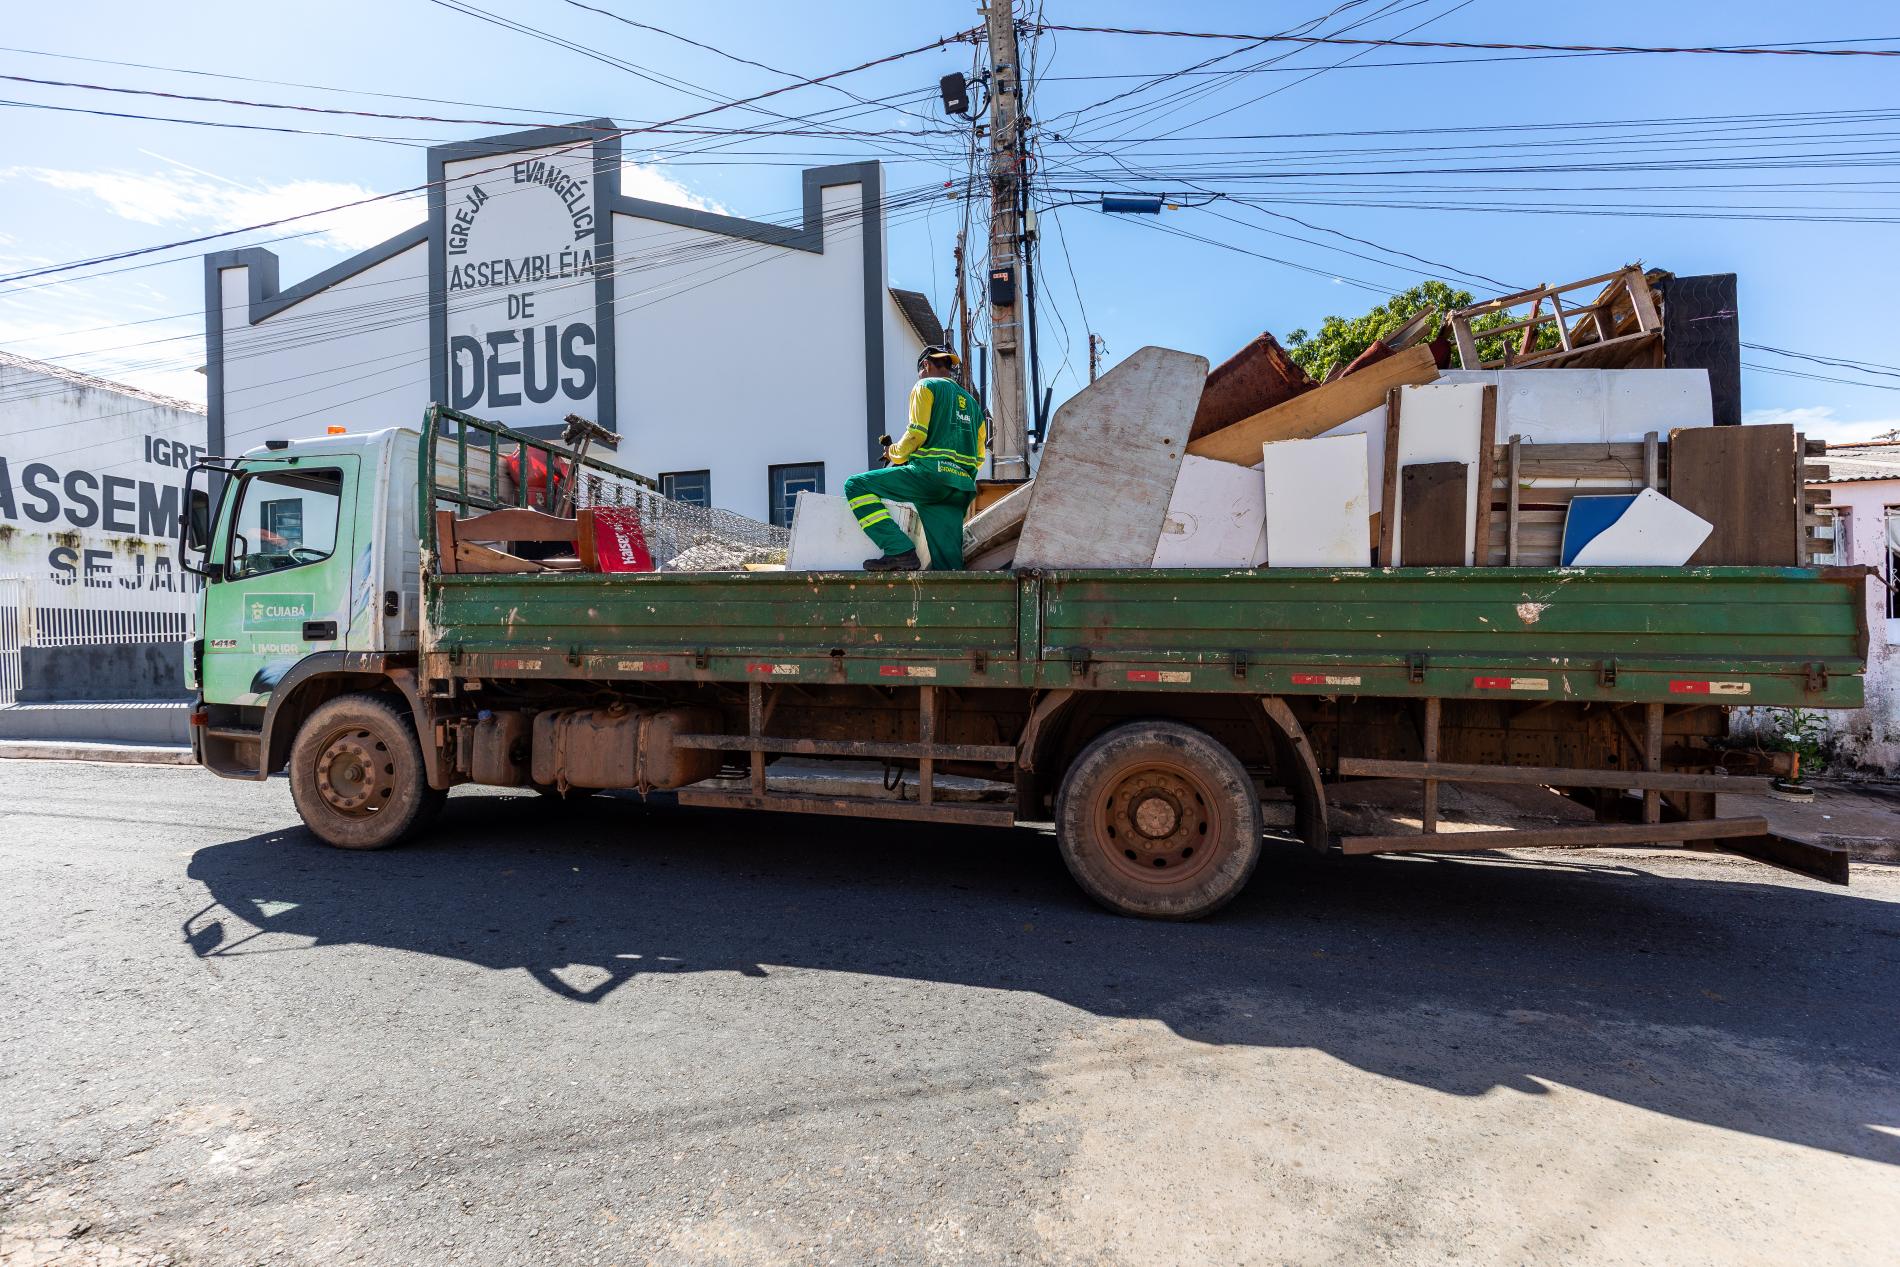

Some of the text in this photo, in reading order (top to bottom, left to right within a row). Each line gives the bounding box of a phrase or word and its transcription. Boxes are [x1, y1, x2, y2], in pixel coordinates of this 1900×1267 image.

[449, 160, 595, 255] IGREJA EVANGÉLICA
[450, 246, 595, 290] ASSEMBLÉIA
[508, 292, 534, 320] DE
[451, 323, 597, 411] DEUS
[0, 457, 187, 539] SSEM
[615, 532, 637, 565] Kaiser
[266, 604, 305, 617] CUIABÁ
